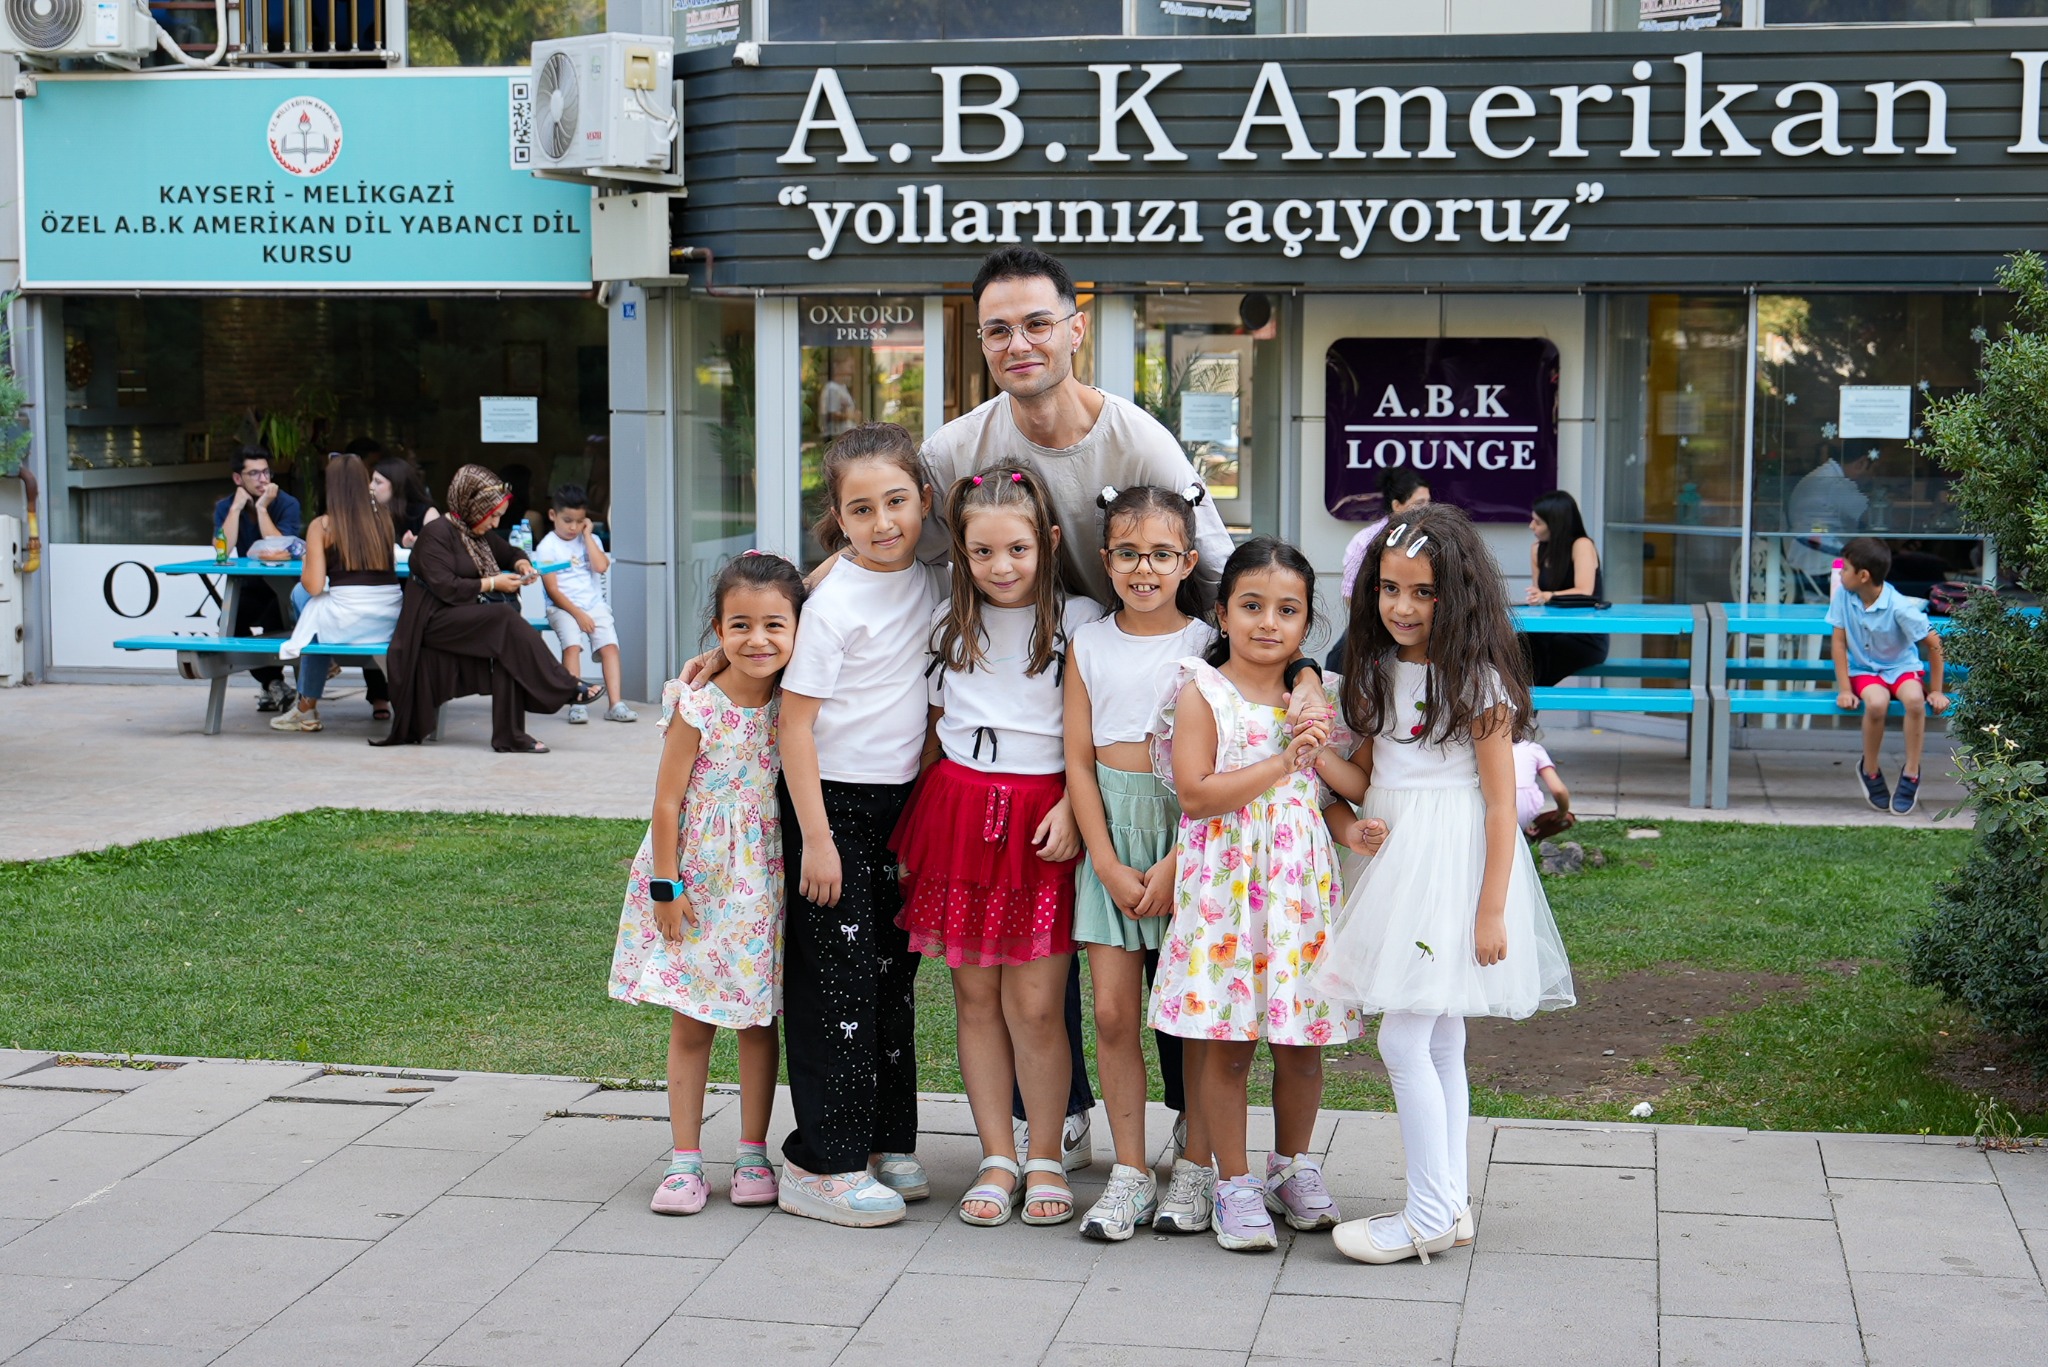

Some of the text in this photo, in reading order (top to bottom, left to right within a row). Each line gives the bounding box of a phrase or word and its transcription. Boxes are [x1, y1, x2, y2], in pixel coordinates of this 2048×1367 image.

[776, 63, 1188, 164] A.B.K
[1217, 51, 1957, 160] Amerikan
[160, 180, 275, 204] KAYSERİ
[304, 179, 455, 204] MELİKGAZİ
[41, 210, 581, 234] ÖZEL A.B.K AMERİKAN DİL YABANCI DİL
[263, 245, 351, 264] KURSU
[809, 305, 914, 325] OXFORD
[836, 327, 889, 341] PRESS
[1373, 384, 1509, 418] A.B.K
[1346, 439, 1536, 470] LOUNGE
